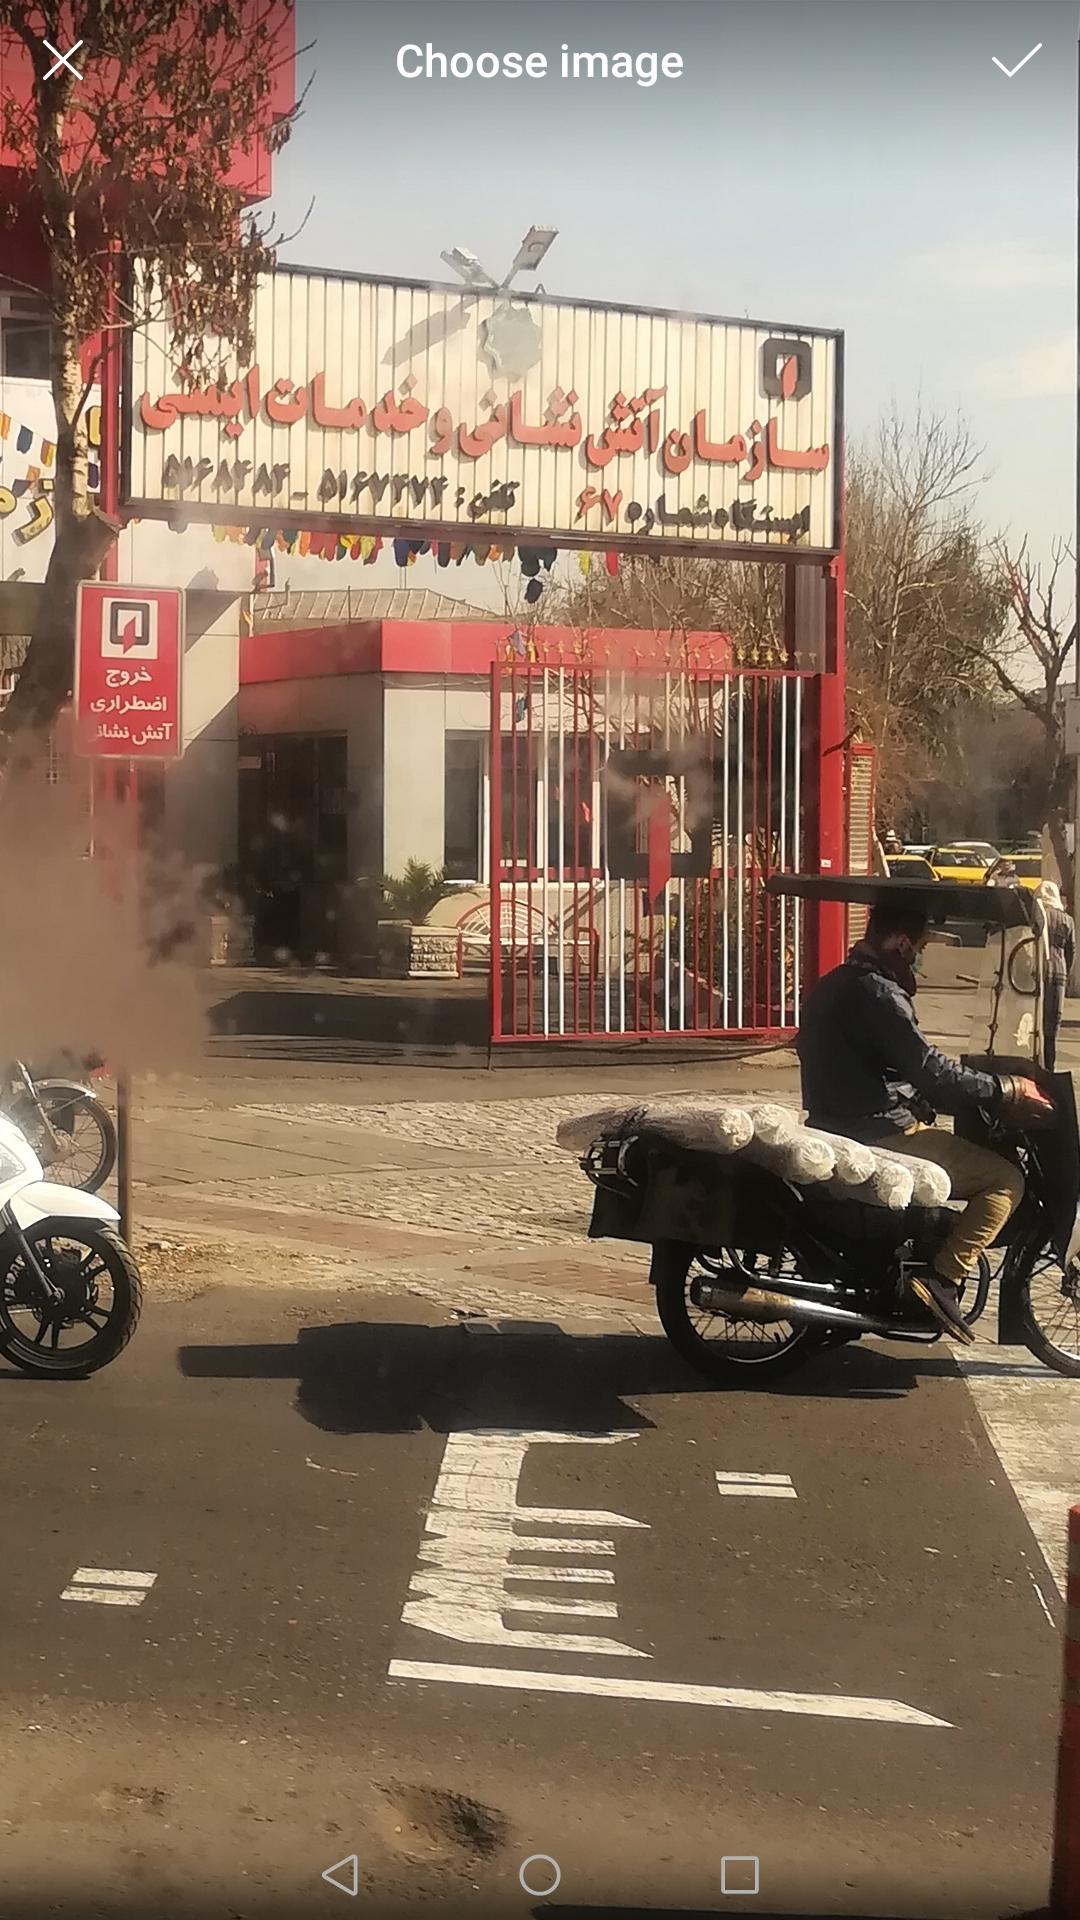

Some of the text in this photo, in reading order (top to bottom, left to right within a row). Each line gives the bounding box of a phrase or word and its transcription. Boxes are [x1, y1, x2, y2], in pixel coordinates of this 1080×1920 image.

[266, 371, 430, 432] خدمات
[429, 407, 452, 454] و
[459, 386, 583, 459] نشانی
[586, 385, 668, 466] آتش
[664, 408, 830, 481] سازمان
[576, 486, 810, 544] ایستگاه شماره ۶۷
[90, 694, 167, 715] اضطراری
[105, 665, 152, 688] خروج
[96, 722, 174, 746] آتش نشان
